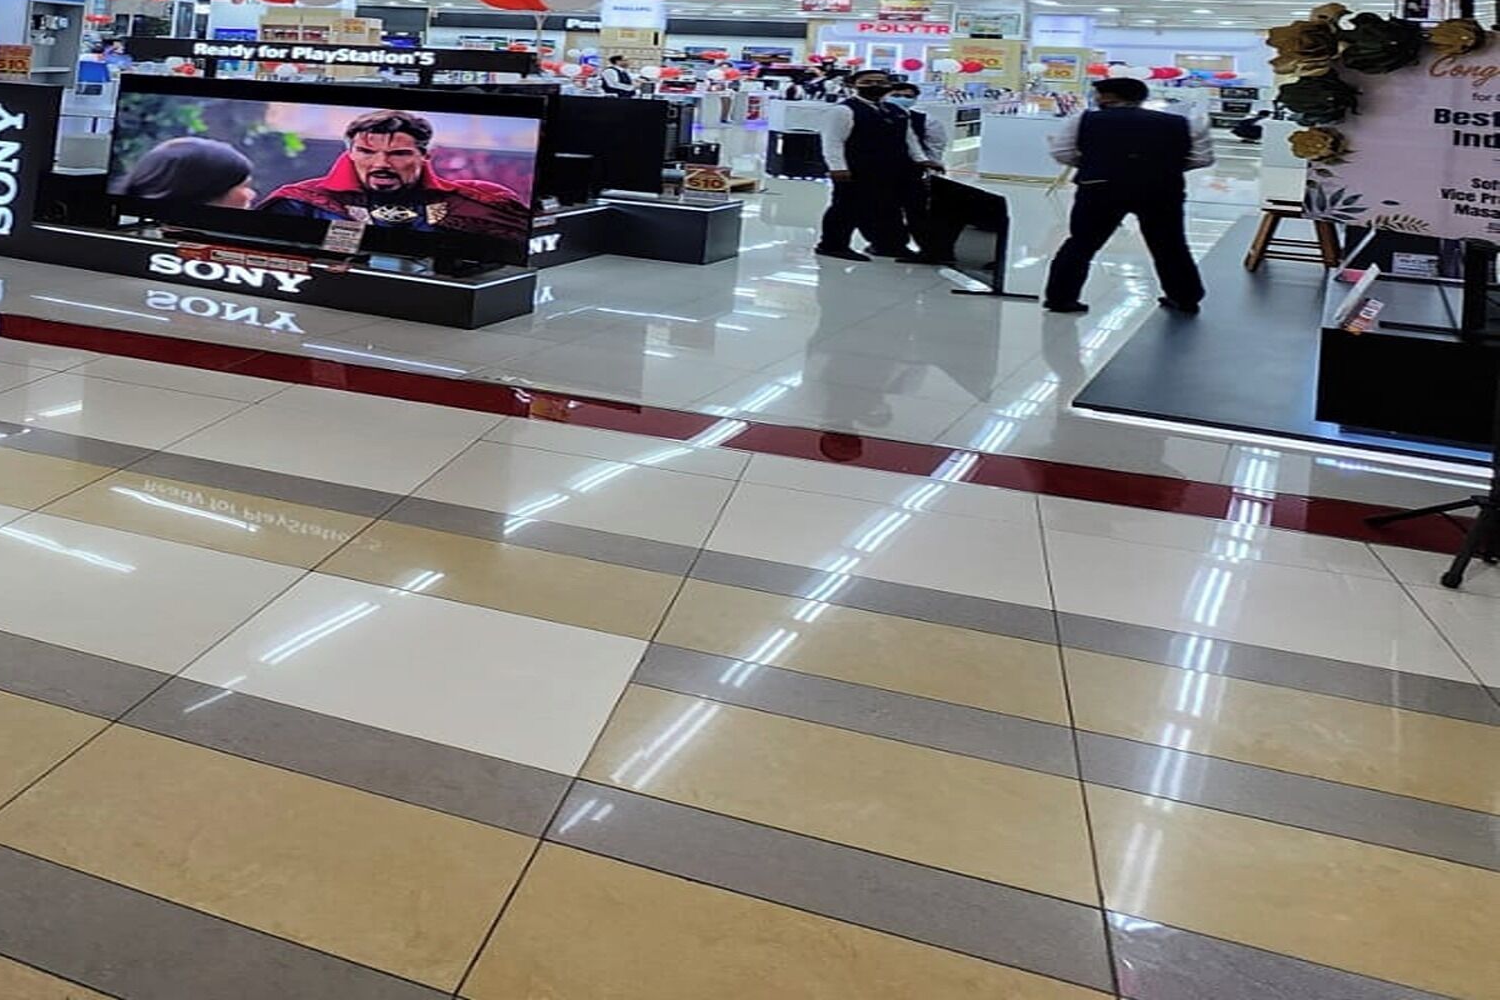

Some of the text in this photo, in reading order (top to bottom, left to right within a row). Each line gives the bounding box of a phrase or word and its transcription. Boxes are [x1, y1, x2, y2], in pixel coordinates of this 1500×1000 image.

[194, 42, 255, 61] Ready
[258, 44, 287, 59] for
[1441, 188, 1476, 202] Vice
[528, 233, 562, 255] NY
[149, 253, 312, 293] SONY
